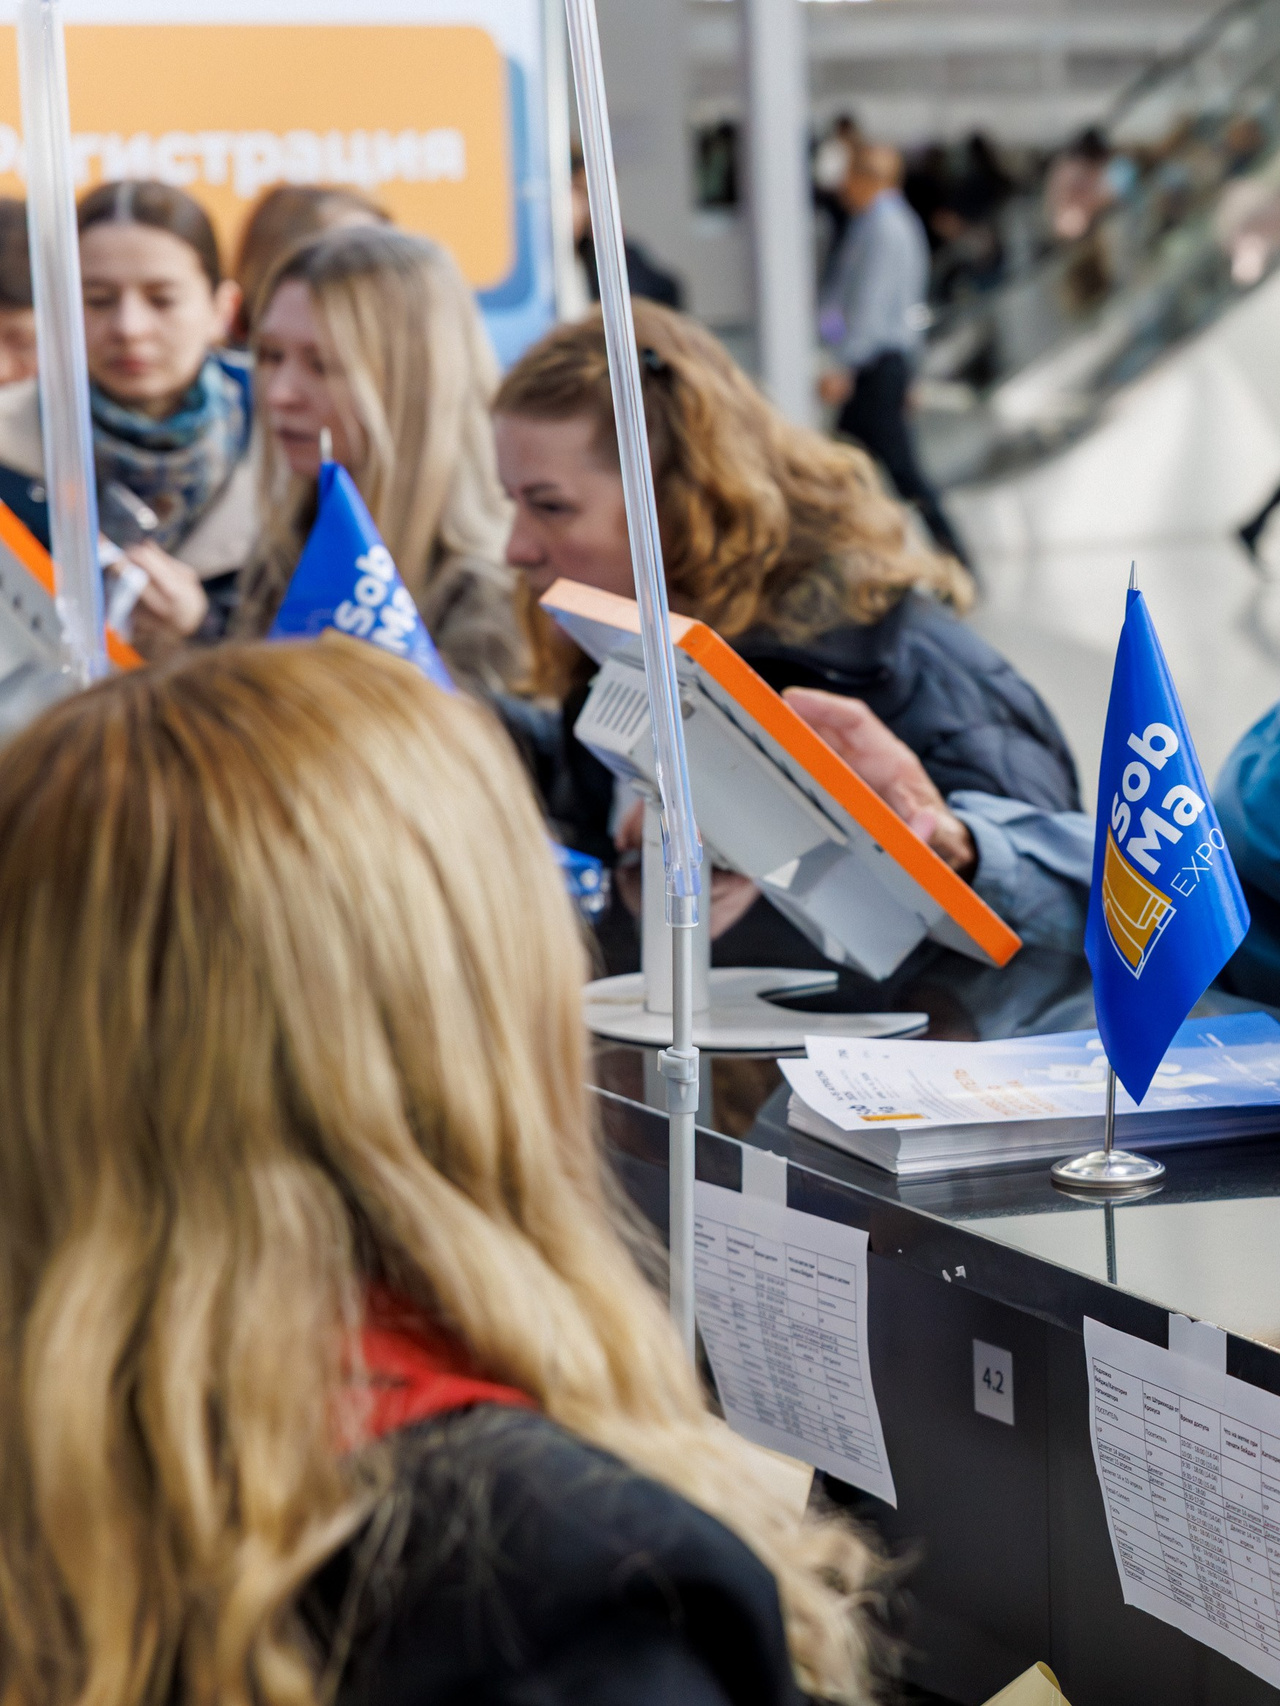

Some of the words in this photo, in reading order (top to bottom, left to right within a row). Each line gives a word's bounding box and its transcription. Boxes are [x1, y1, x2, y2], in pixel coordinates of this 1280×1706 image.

[0, 123, 466, 199] гистрация
[1126, 784, 1206, 875] Ma
[1170, 828, 1225, 897] EXPO
[983, 1367, 1004, 1394] 4.2
[1096, 1405, 1118, 1421] ПОСЕТИТЕЛЬ
[1144, 1404, 1161, 1415] Крокуса
[1180, 1414, 1193, 1424] Время
[1193, 1421, 1209, 1432] доступа
[1145, 1429, 1167, 1443] Посетитель
[1223, 1427, 1231, 1436] Что
[1250, 1440, 1258, 1448] при
[1098, 1441, 1112, 1452] Делегат
[1118, 1452, 1131, 1460] апреля
[1226, 1440, 1240, 1450] печати
[1240, 1445, 1256, 1458] бейджа
[1100, 1451, 1114, 1463] Делегат
[1119, 1462, 1132, 1471] апреля
[1102, 1466, 1116, 1477] Делегат
[1129, 1481, 1143, 1491] апреля
[1147, 1465, 1163, 1476] Делегат
[1149, 1475, 1164, 1487] Делегат
[1151, 1491, 1167, 1502] Делегат
[1154, 1511, 1170, 1522] Делегат
[1226, 1502, 1241, 1512] Делегат
[1247, 1513, 1262, 1523] апреля
[1226, 1512, 1242, 1523] Делегат
[1248, 1524, 1262, 1533] апреля
[1230, 1524, 1246, 1535] Делегат
[1263, 1520, 1280, 1531] Делегат
[1240, 1540, 1254, 1549] апреля
[1264, 1530, 1280, 1542] Делегат
